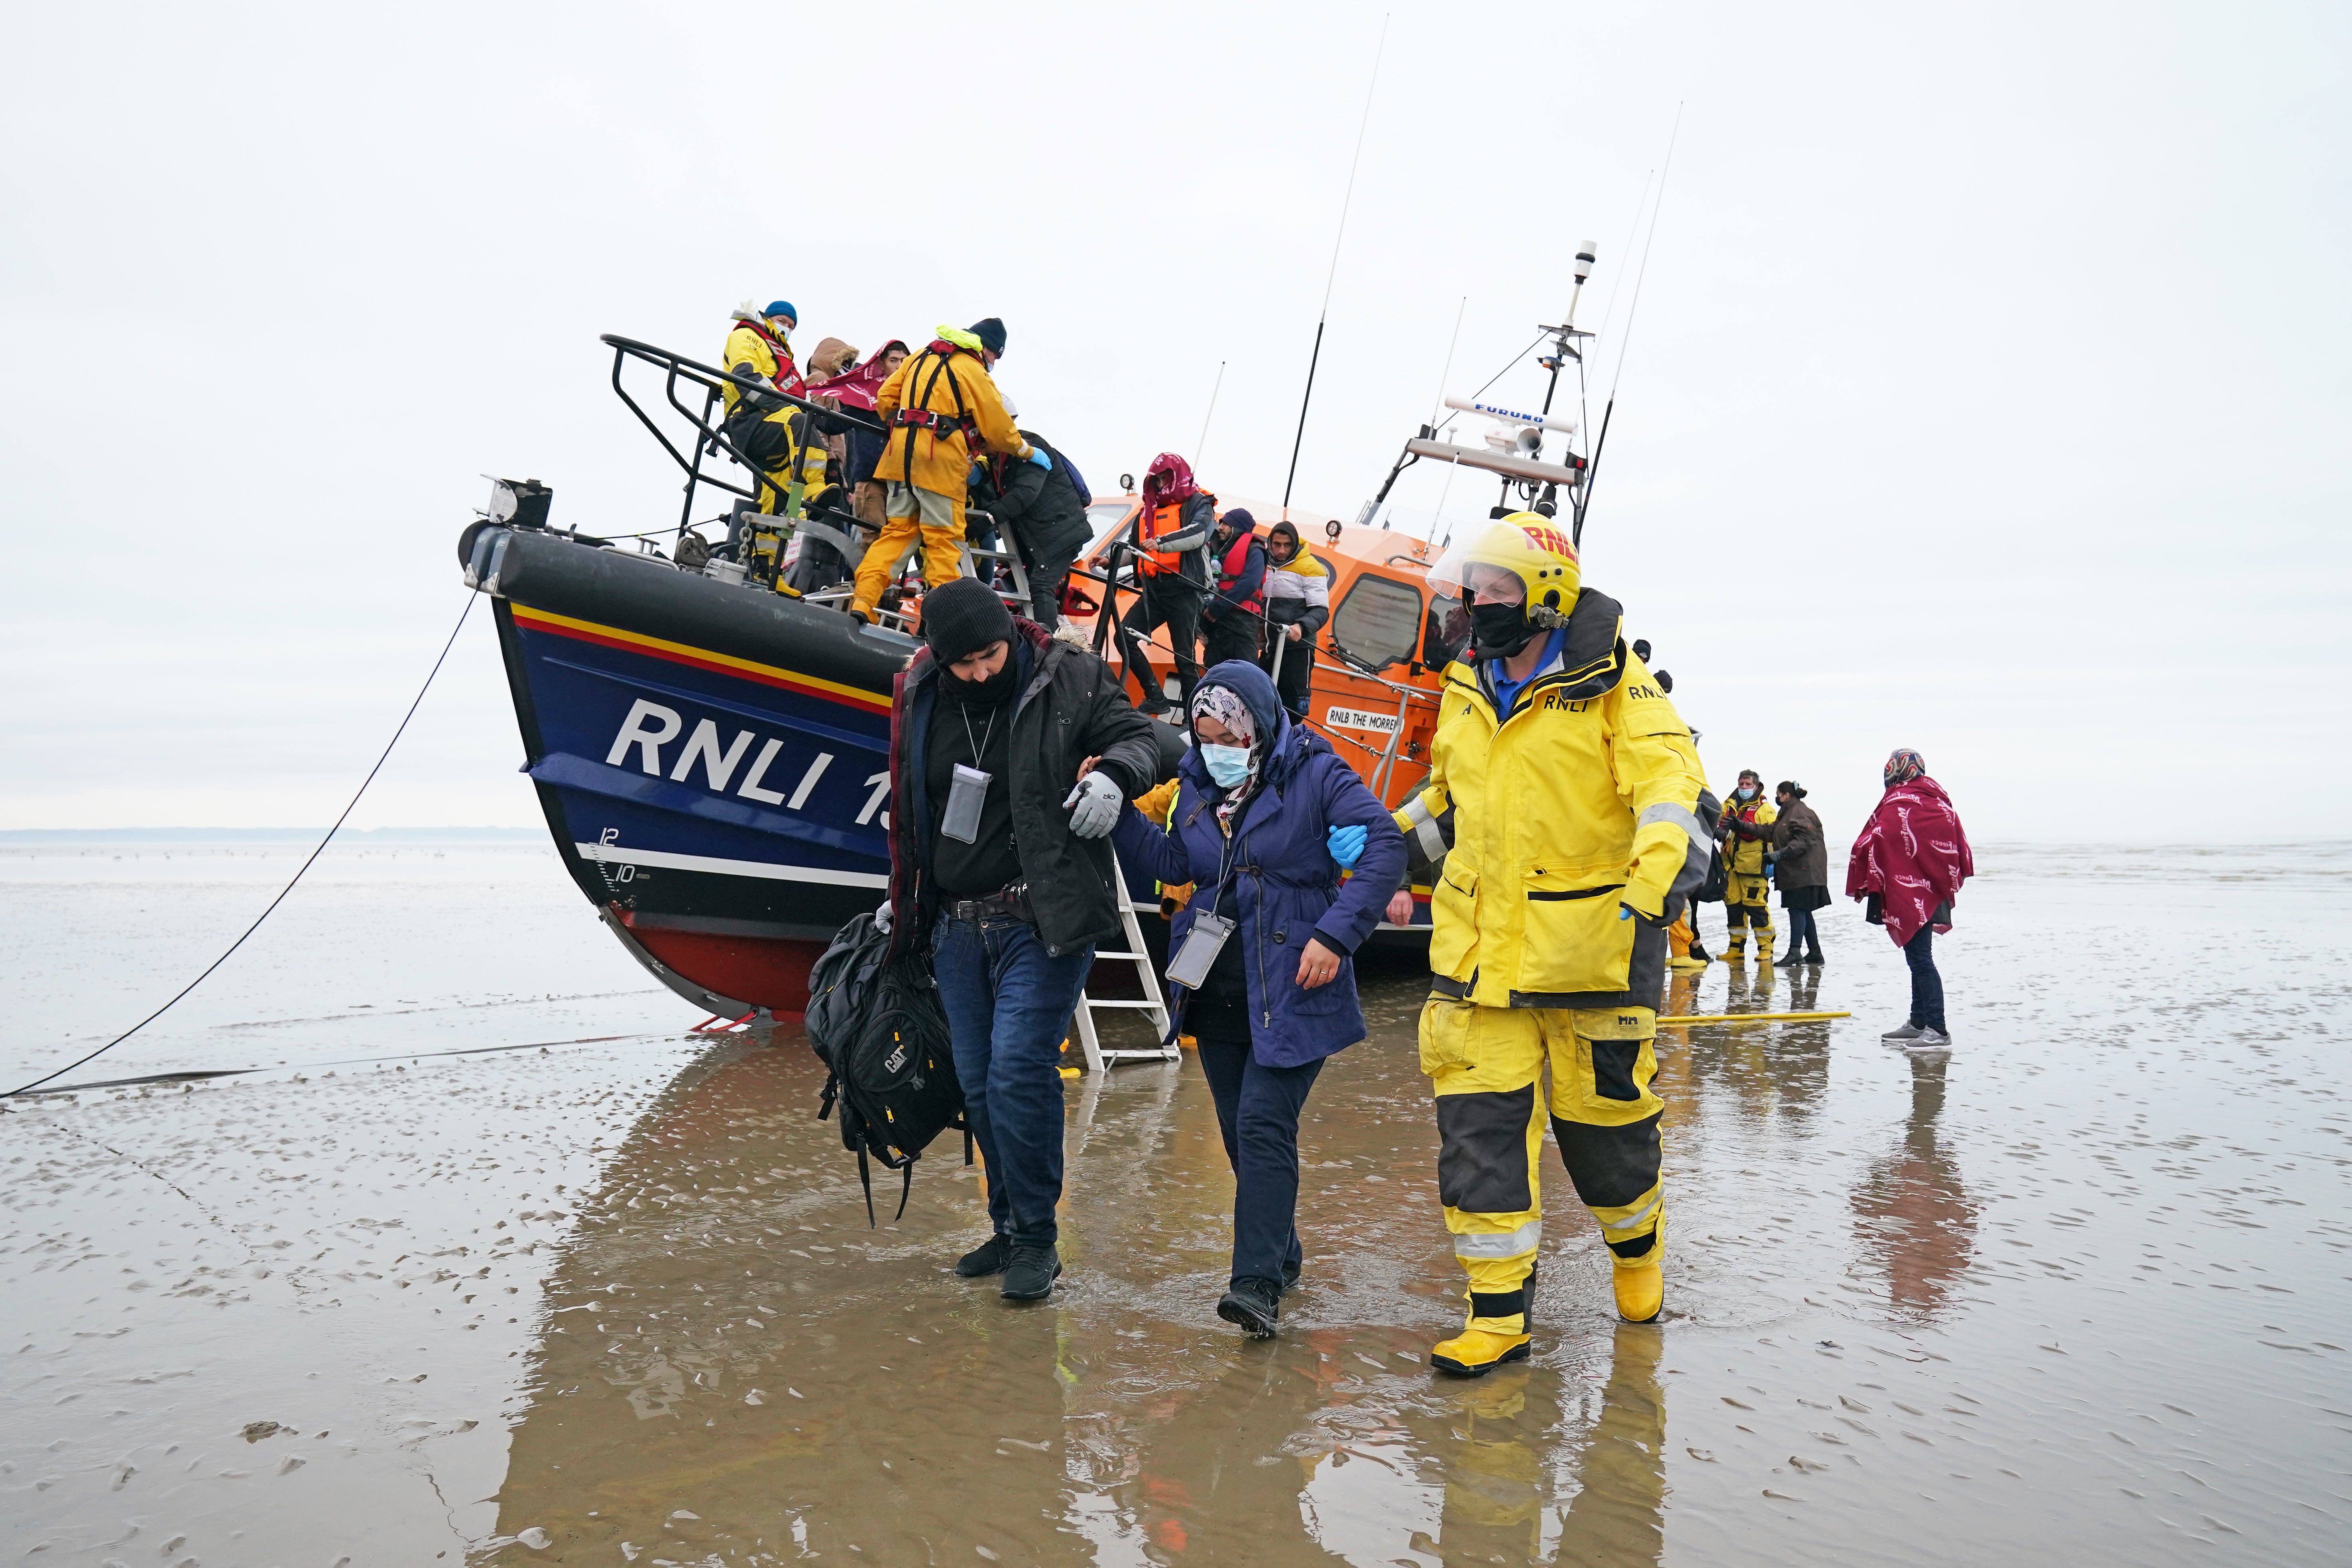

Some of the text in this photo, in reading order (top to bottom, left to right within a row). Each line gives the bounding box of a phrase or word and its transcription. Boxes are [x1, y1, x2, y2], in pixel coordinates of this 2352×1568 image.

[1475, 404, 1543, 423] FURUNO
[1628, 685, 1667, 700] RNLI
[1544, 695, 1589, 712] RNLI
[1330, 710, 1350, 723] RNLB
[1353, 713, 1367, 726] THE
[606, 698, 834, 810] RNLI
[599, 827, 619, 847] 12
[616, 864, 635, 883] 10
[1618, 1015, 1638, 1025] HH
[885, 1046, 908, 1073] CAT
